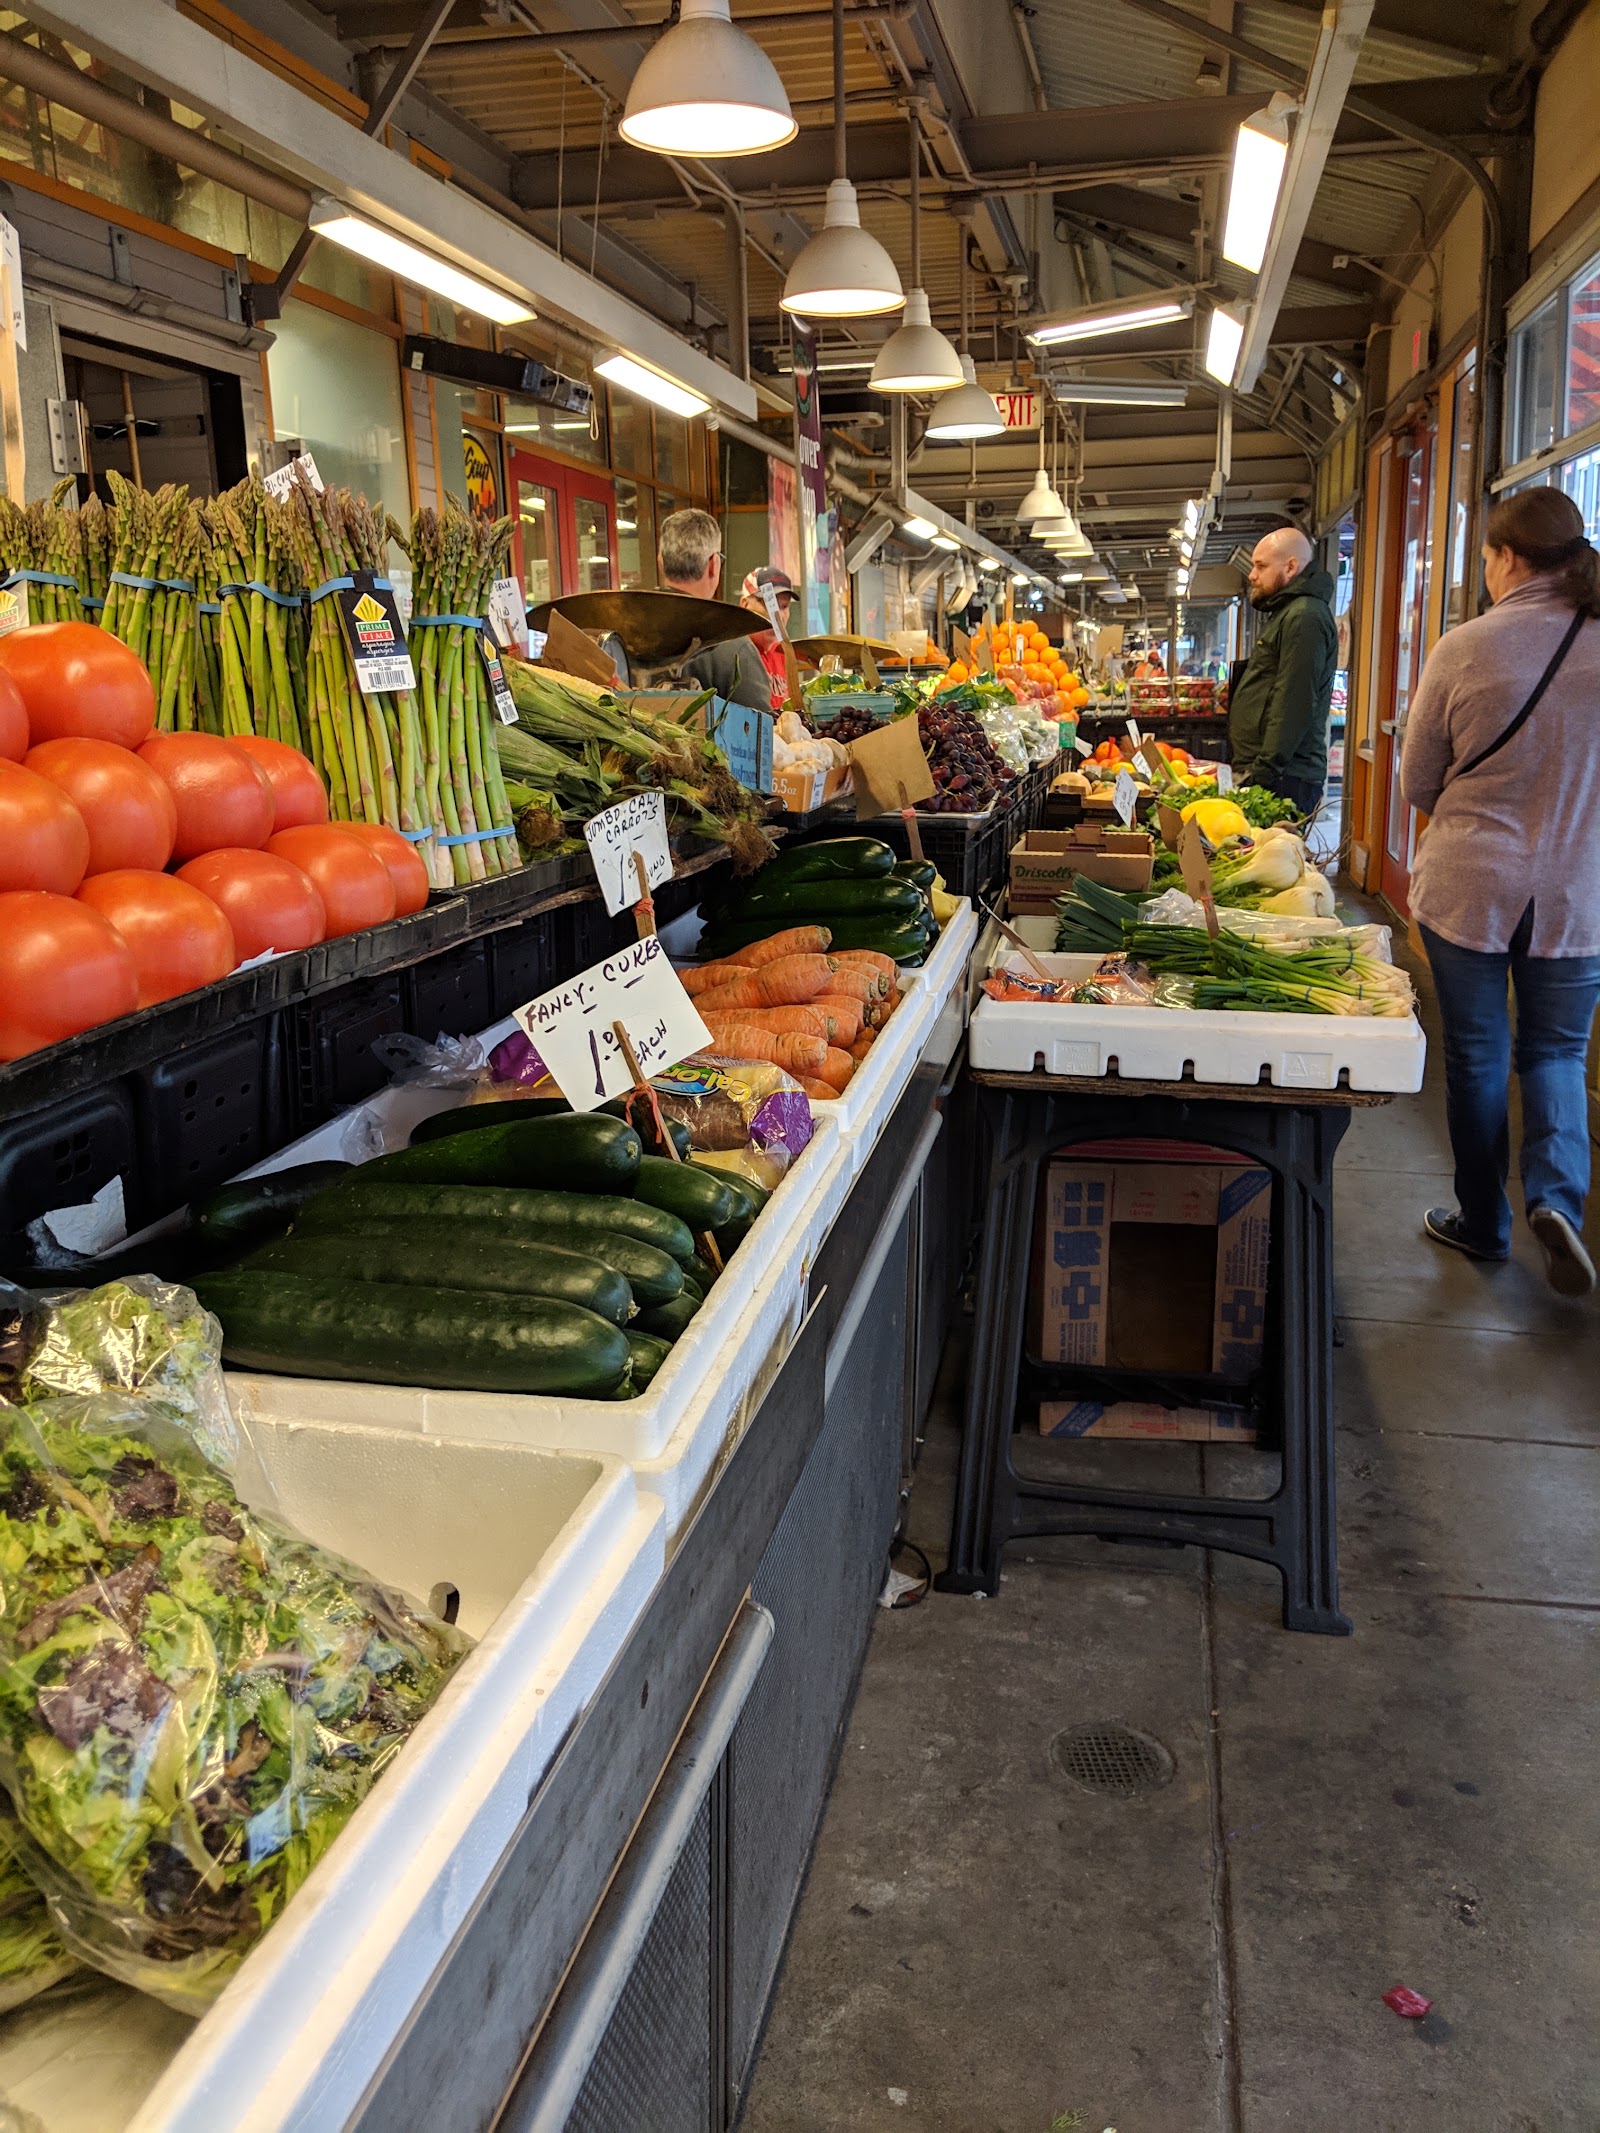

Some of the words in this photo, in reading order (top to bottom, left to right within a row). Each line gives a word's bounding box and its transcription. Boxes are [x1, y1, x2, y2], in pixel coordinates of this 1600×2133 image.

[800, 434, 820, 469] ower
[360, 622, 388, 631] PRIME
[362, 631, 391, 640] TIME
[606, 805, 658, 843] CARROTS
[1014, 864, 1073, 878] Driscoll's
[602, 938, 661, 981] CUKES
